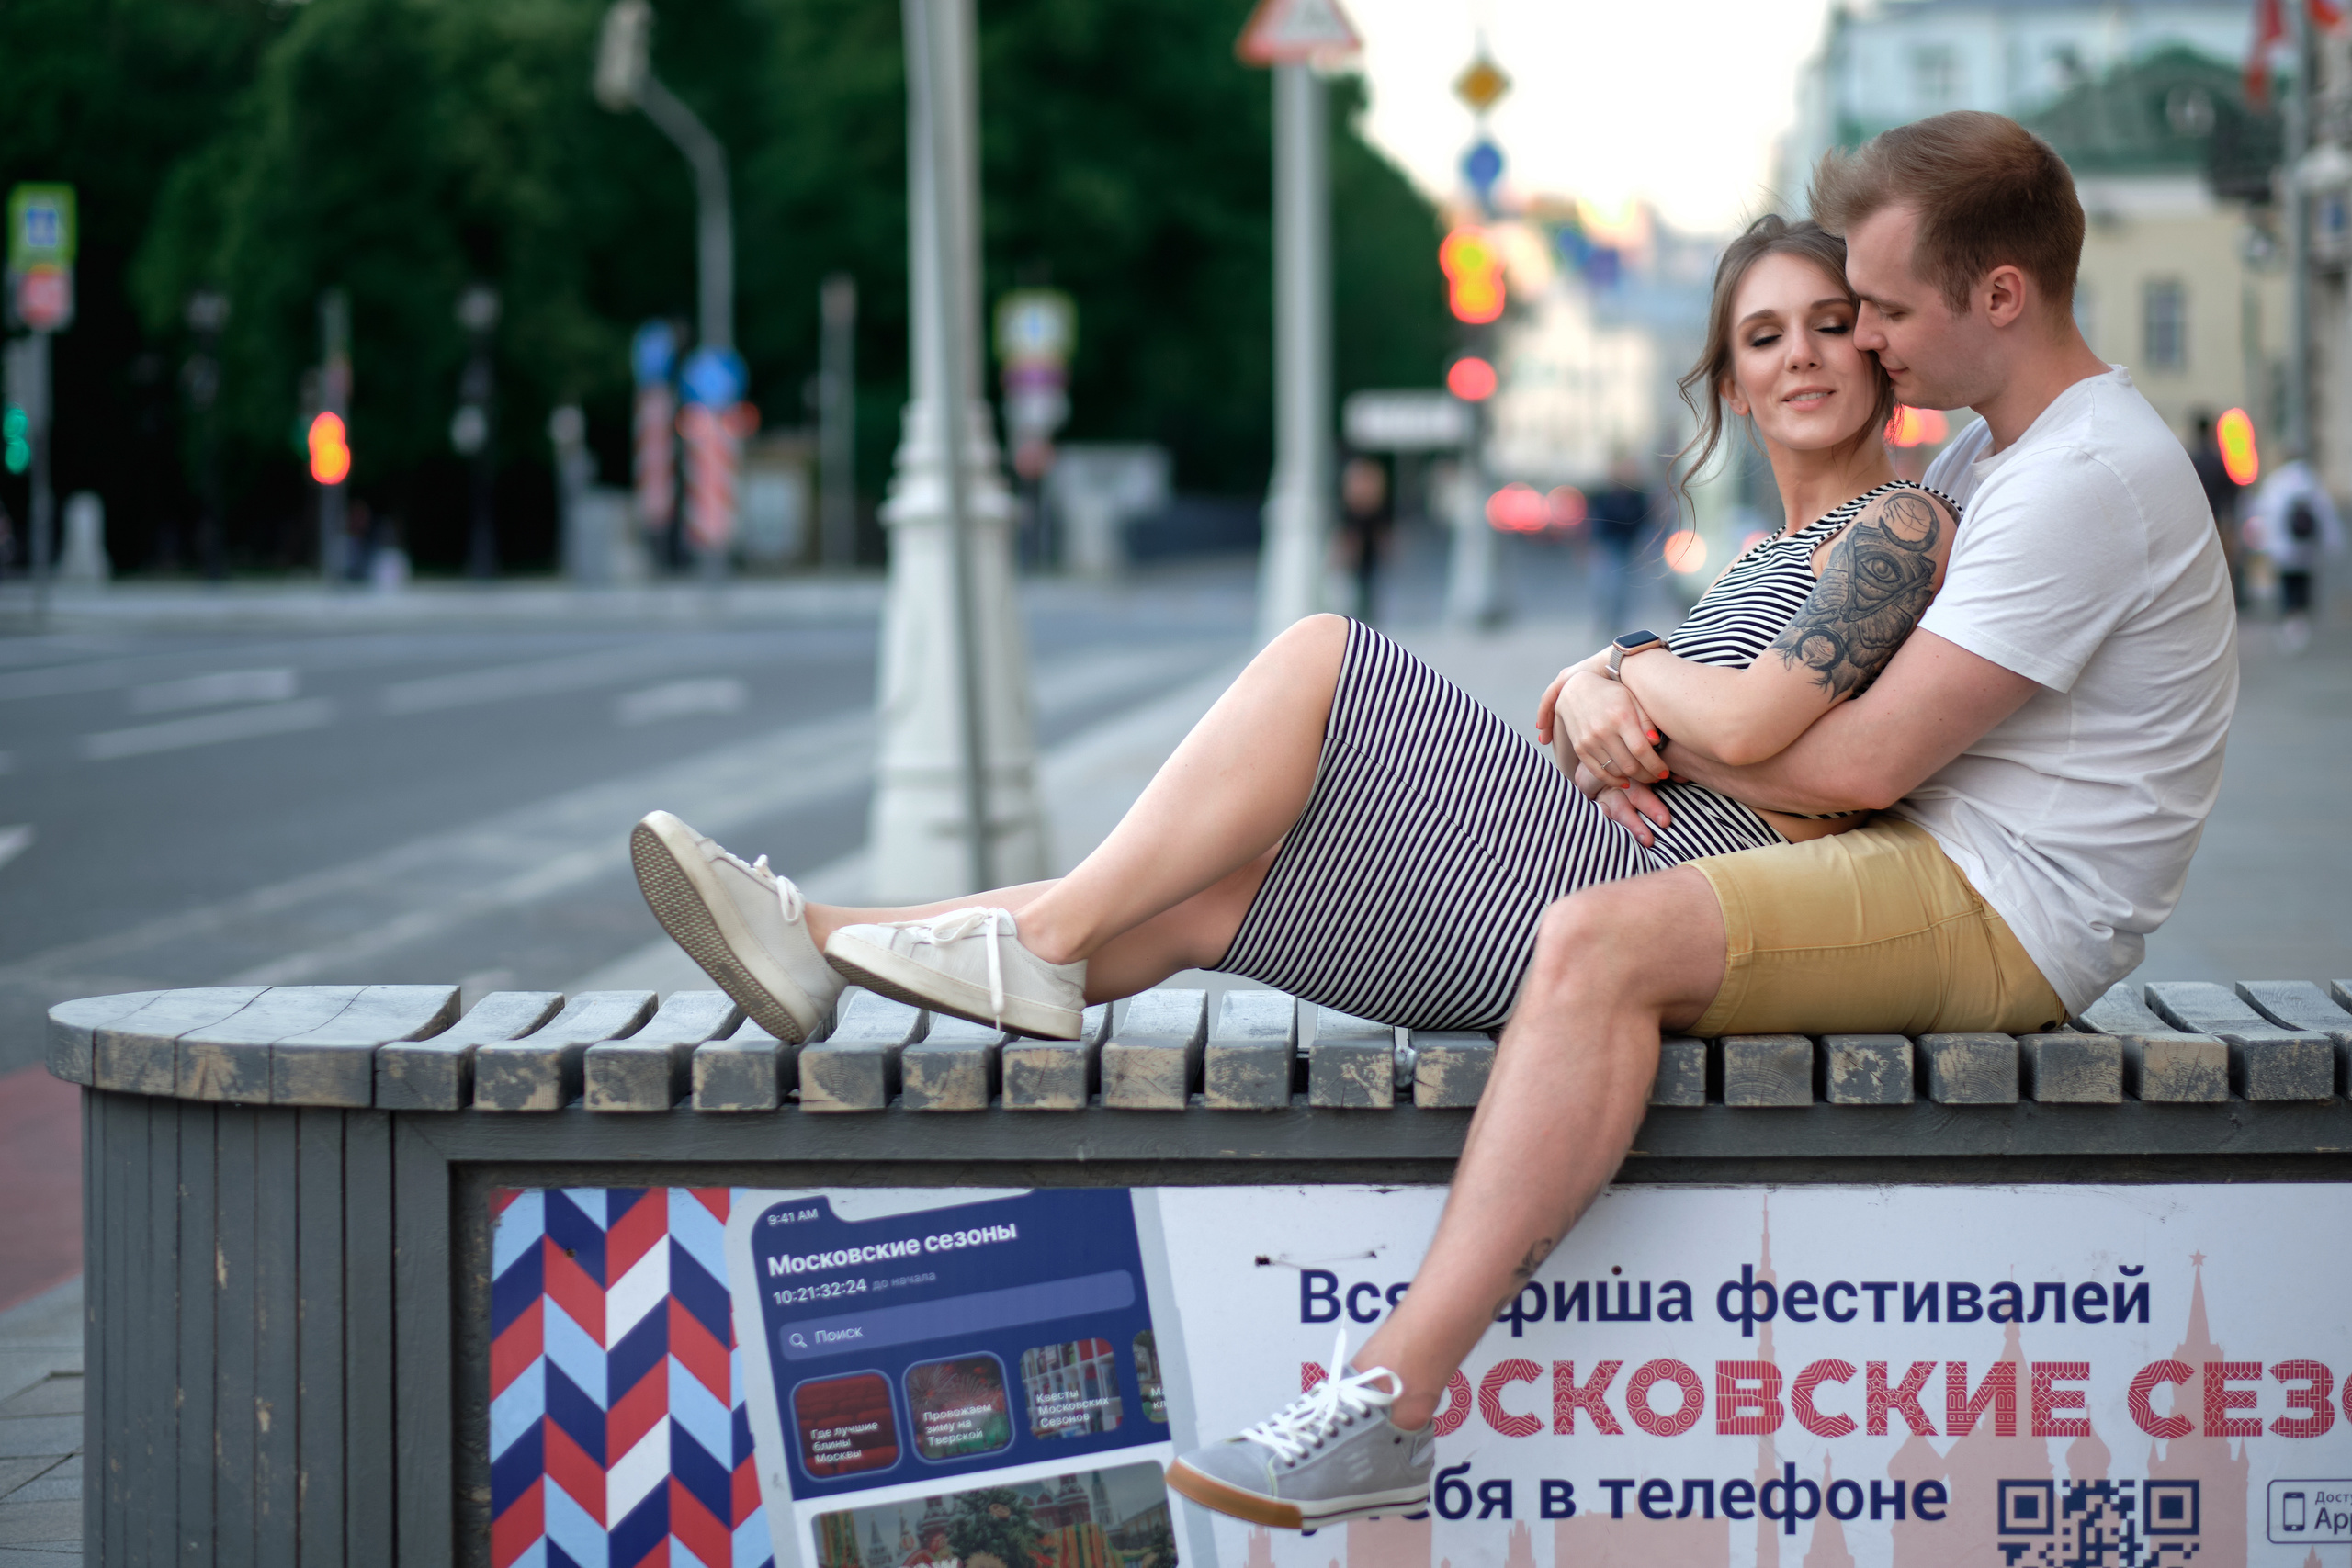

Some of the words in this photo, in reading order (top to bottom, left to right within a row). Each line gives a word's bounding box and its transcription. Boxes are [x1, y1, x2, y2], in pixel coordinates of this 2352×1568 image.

[767, 1212, 795, 1226] 9:41
[797, 1208, 819, 1222] AM
[767, 1238, 921, 1277] Московские
[924, 1223, 1017, 1252] сезоны
[773, 1278, 866, 1305] 10:21:32:24
[872, 1279, 888, 1292] до
[891, 1271, 936, 1286] начала
[1492, 1280, 1693, 1337] фиша
[1716, 1264, 2150, 1337] фестивалей
[815, 1326, 863, 1345] Поиск
[1036, 1390, 1079, 1404] Квесты
[2127, 1359, 2352, 1439] СЕЗ
[923, 1404, 992, 1422] Провожаем
[1038, 1397, 1109, 1416] Московских
[926, 1422, 955, 1434] зиму
[957, 1419, 972, 1429] на
[1040, 1413, 1090, 1427] Сезонов
[810, 1428, 831, 1440] Где
[834, 1422, 878, 1438] лучшие
[927, 1428, 983, 1447] Тверской
[813, 1438, 851, 1452] блины
[814, 1450, 862, 1465] Москвы
[1540, 1479, 1577, 1519] в
[1599, 1461, 1948, 1535] телефоне
[2315, 1491, 2352, 1505] Дост
[2314, 1507, 2352, 1535] Ap
